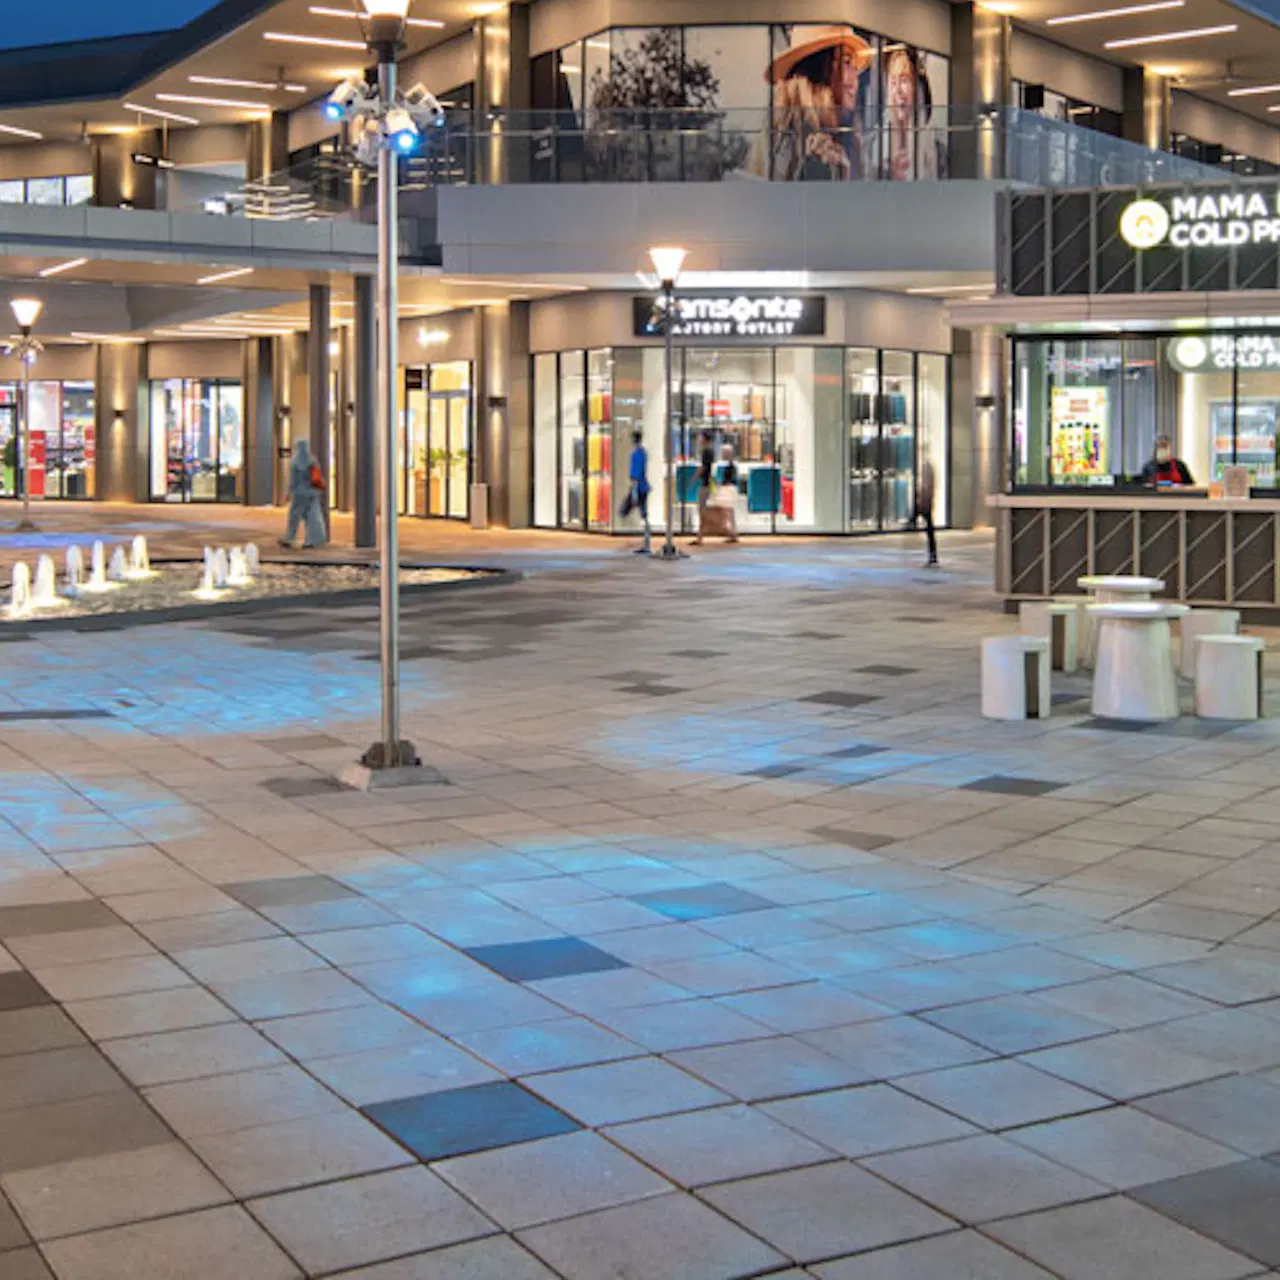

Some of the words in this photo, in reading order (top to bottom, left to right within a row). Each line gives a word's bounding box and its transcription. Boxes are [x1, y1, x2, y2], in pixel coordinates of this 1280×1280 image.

[1171, 193, 1268, 220] MAMA
[1170, 221, 1250, 247] COLD
[671, 321, 731, 335] ACTORY
[736, 321, 796, 335] OUTLET
[1210, 334, 1274, 352] MAMA
[1214, 352, 1263, 367] COLD
